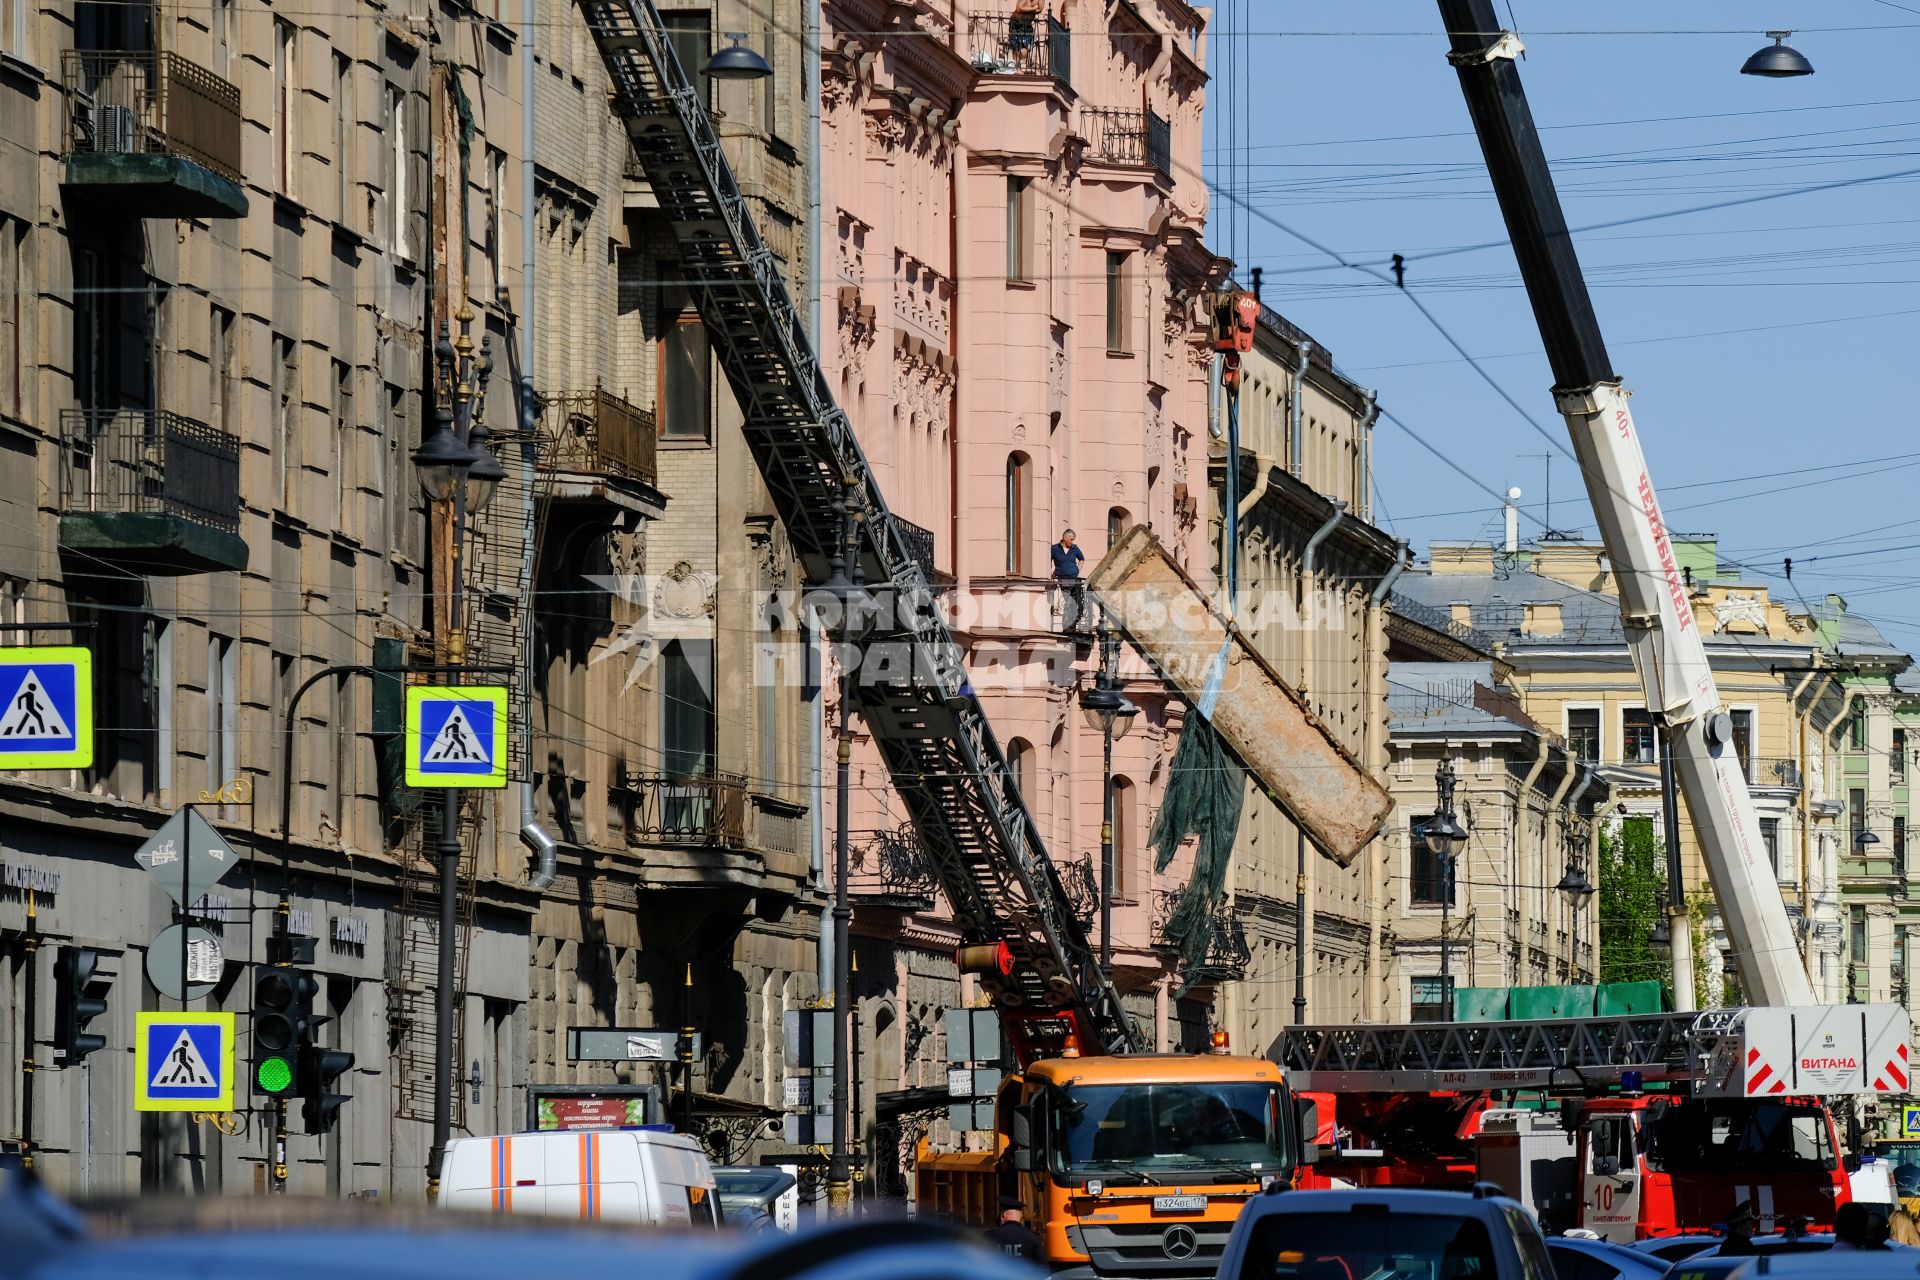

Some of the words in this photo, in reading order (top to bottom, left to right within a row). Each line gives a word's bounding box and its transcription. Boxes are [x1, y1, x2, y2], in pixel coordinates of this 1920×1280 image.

[1615, 409, 1630, 440] 40т
[1637, 471, 1692, 633] ЧЕЛЯБИНЕЦ
[1443, 1072, 1466, 1084] АЛ-42
[1801, 1057, 1857, 1069] ВИТАНД
[781, 1192, 791, 1231] ЫШКИ
[1594, 1183, 1614, 1212] 10
